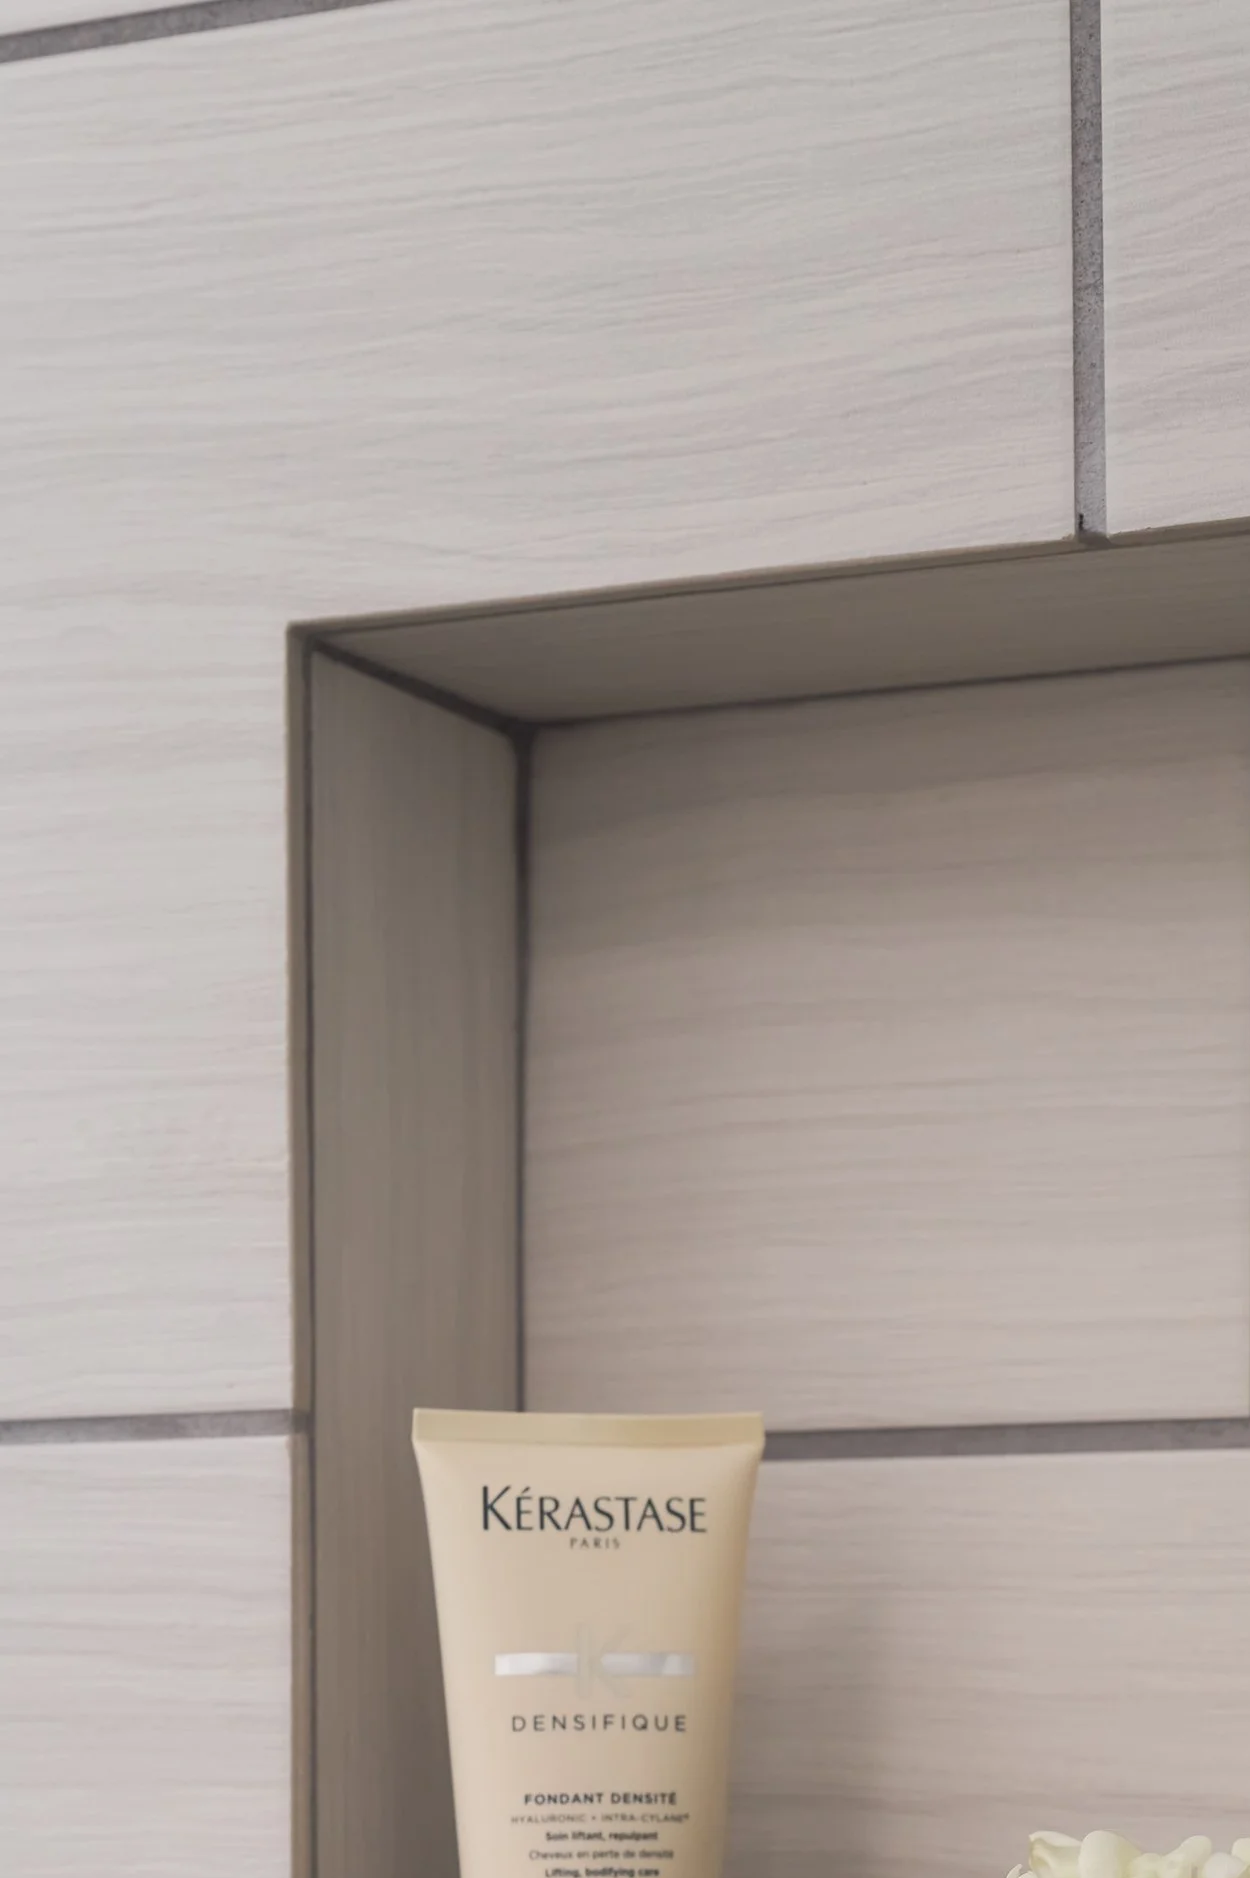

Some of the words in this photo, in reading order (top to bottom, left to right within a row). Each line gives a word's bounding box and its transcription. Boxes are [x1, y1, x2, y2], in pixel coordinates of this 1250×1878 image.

[482, 1485, 707, 1533] KÉRASTASE
[569, 1537, 620, 1549] PARIS
[511, 1713, 686, 1732] DENSIFIQUE
[524, 1793, 604, 1806] FONDANT
[610, 1791, 677, 1805] DENSITÉ
[511, 1814, 586, 1824] HYALURONIC
[545, 1831, 568, 1841] Soin
[608, 1831, 658, 1842] repulpant
[529, 1849, 573, 1860] Cheveux
[592, 1850, 620, 1860] perte
[623, 1849, 636, 1858] de
[638, 1849, 674, 1859] densité
[545, 1868, 582, 1878] Lifting,
[585, 1866, 635, 1878] bodifying
[638, 1868, 660, 1877] care
